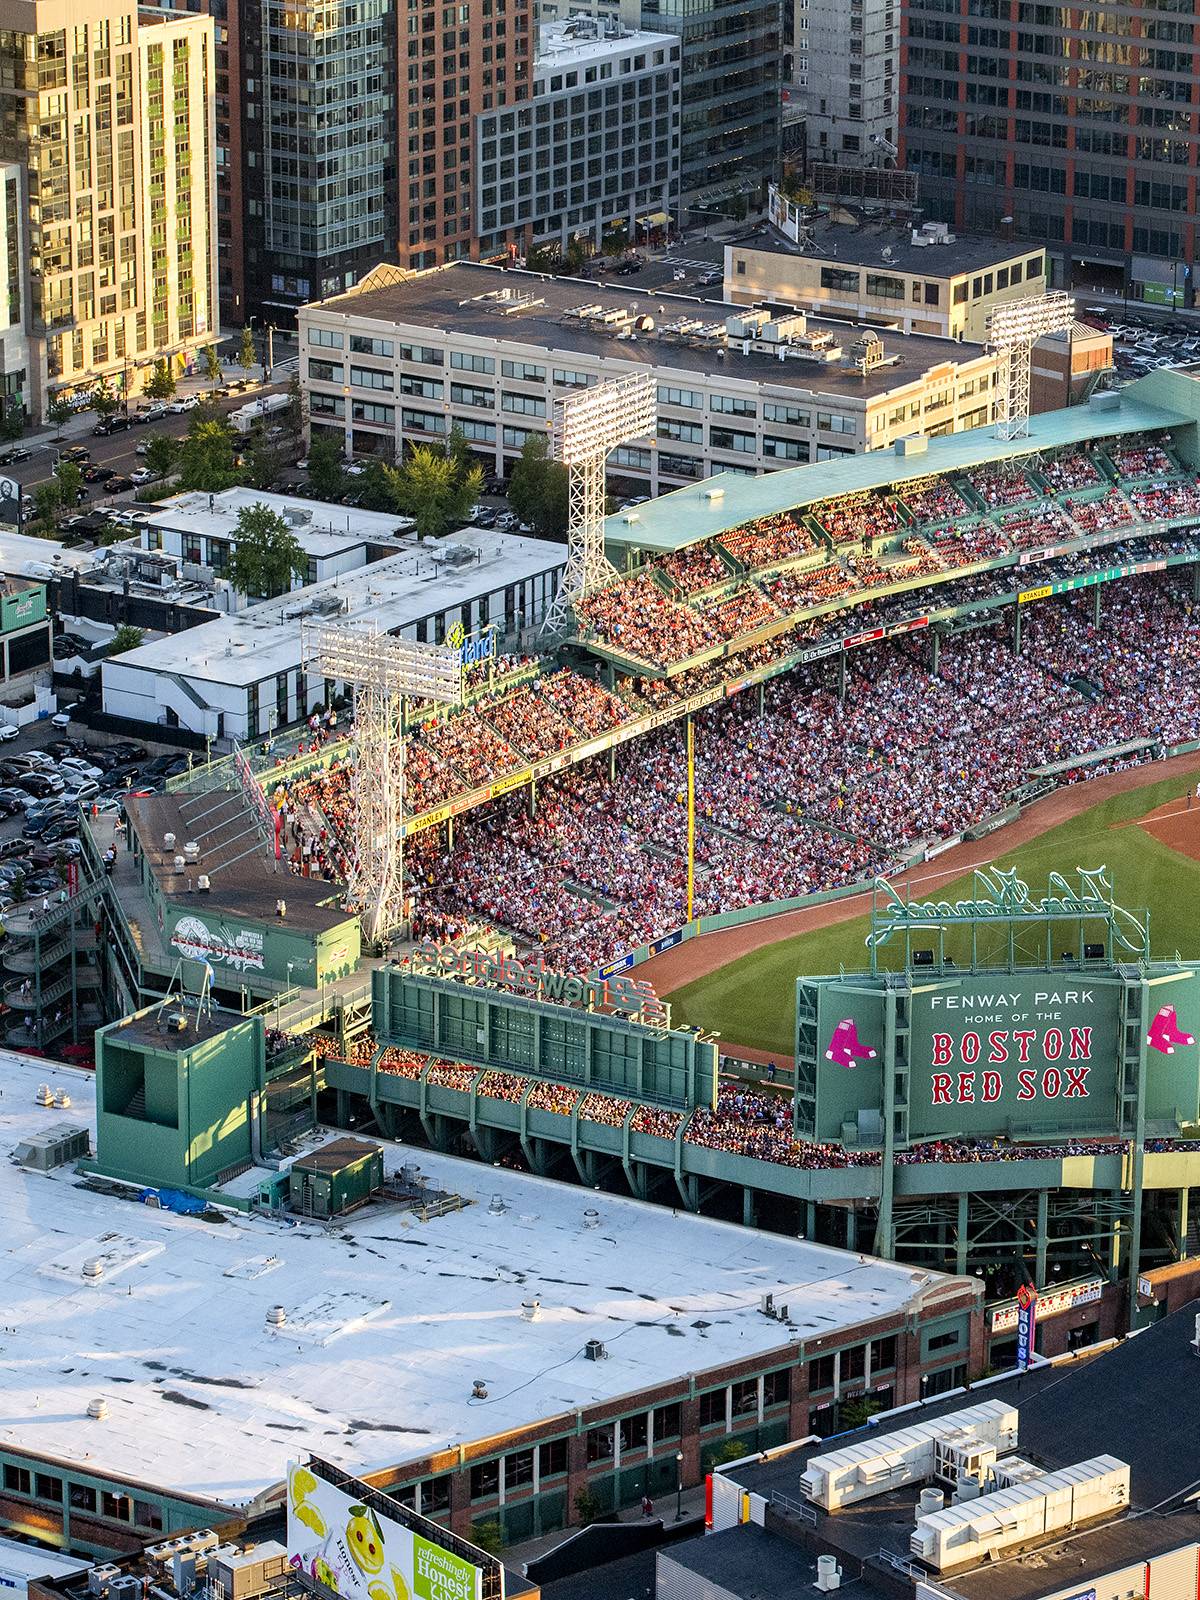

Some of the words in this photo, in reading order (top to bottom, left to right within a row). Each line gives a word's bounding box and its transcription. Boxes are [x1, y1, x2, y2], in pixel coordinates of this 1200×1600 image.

[1022, 588, 1049, 601] STANLEY
[414, 811, 444, 830] STANLEY
[930, 993, 1023, 1011] FENWAY
[1034, 990, 1095, 1006] PARK
[964, 1013, 1003, 1025] HOME
[1011, 1012, 1030, 1023] OF
[1036, 1011, 1063, 1022] THE
[930, 1026, 1093, 1067] BOSTON
[930, 1071, 1004, 1106] RED
[1017, 1066, 1092, 1102] SOX
[1018, 1309, 1029, 1370] HOUSE
[335, 1537, 361, 1588] Honest
[417, 1547, 471, 1586] refreshingly
[417, 1557, 472, 1600] Honest
